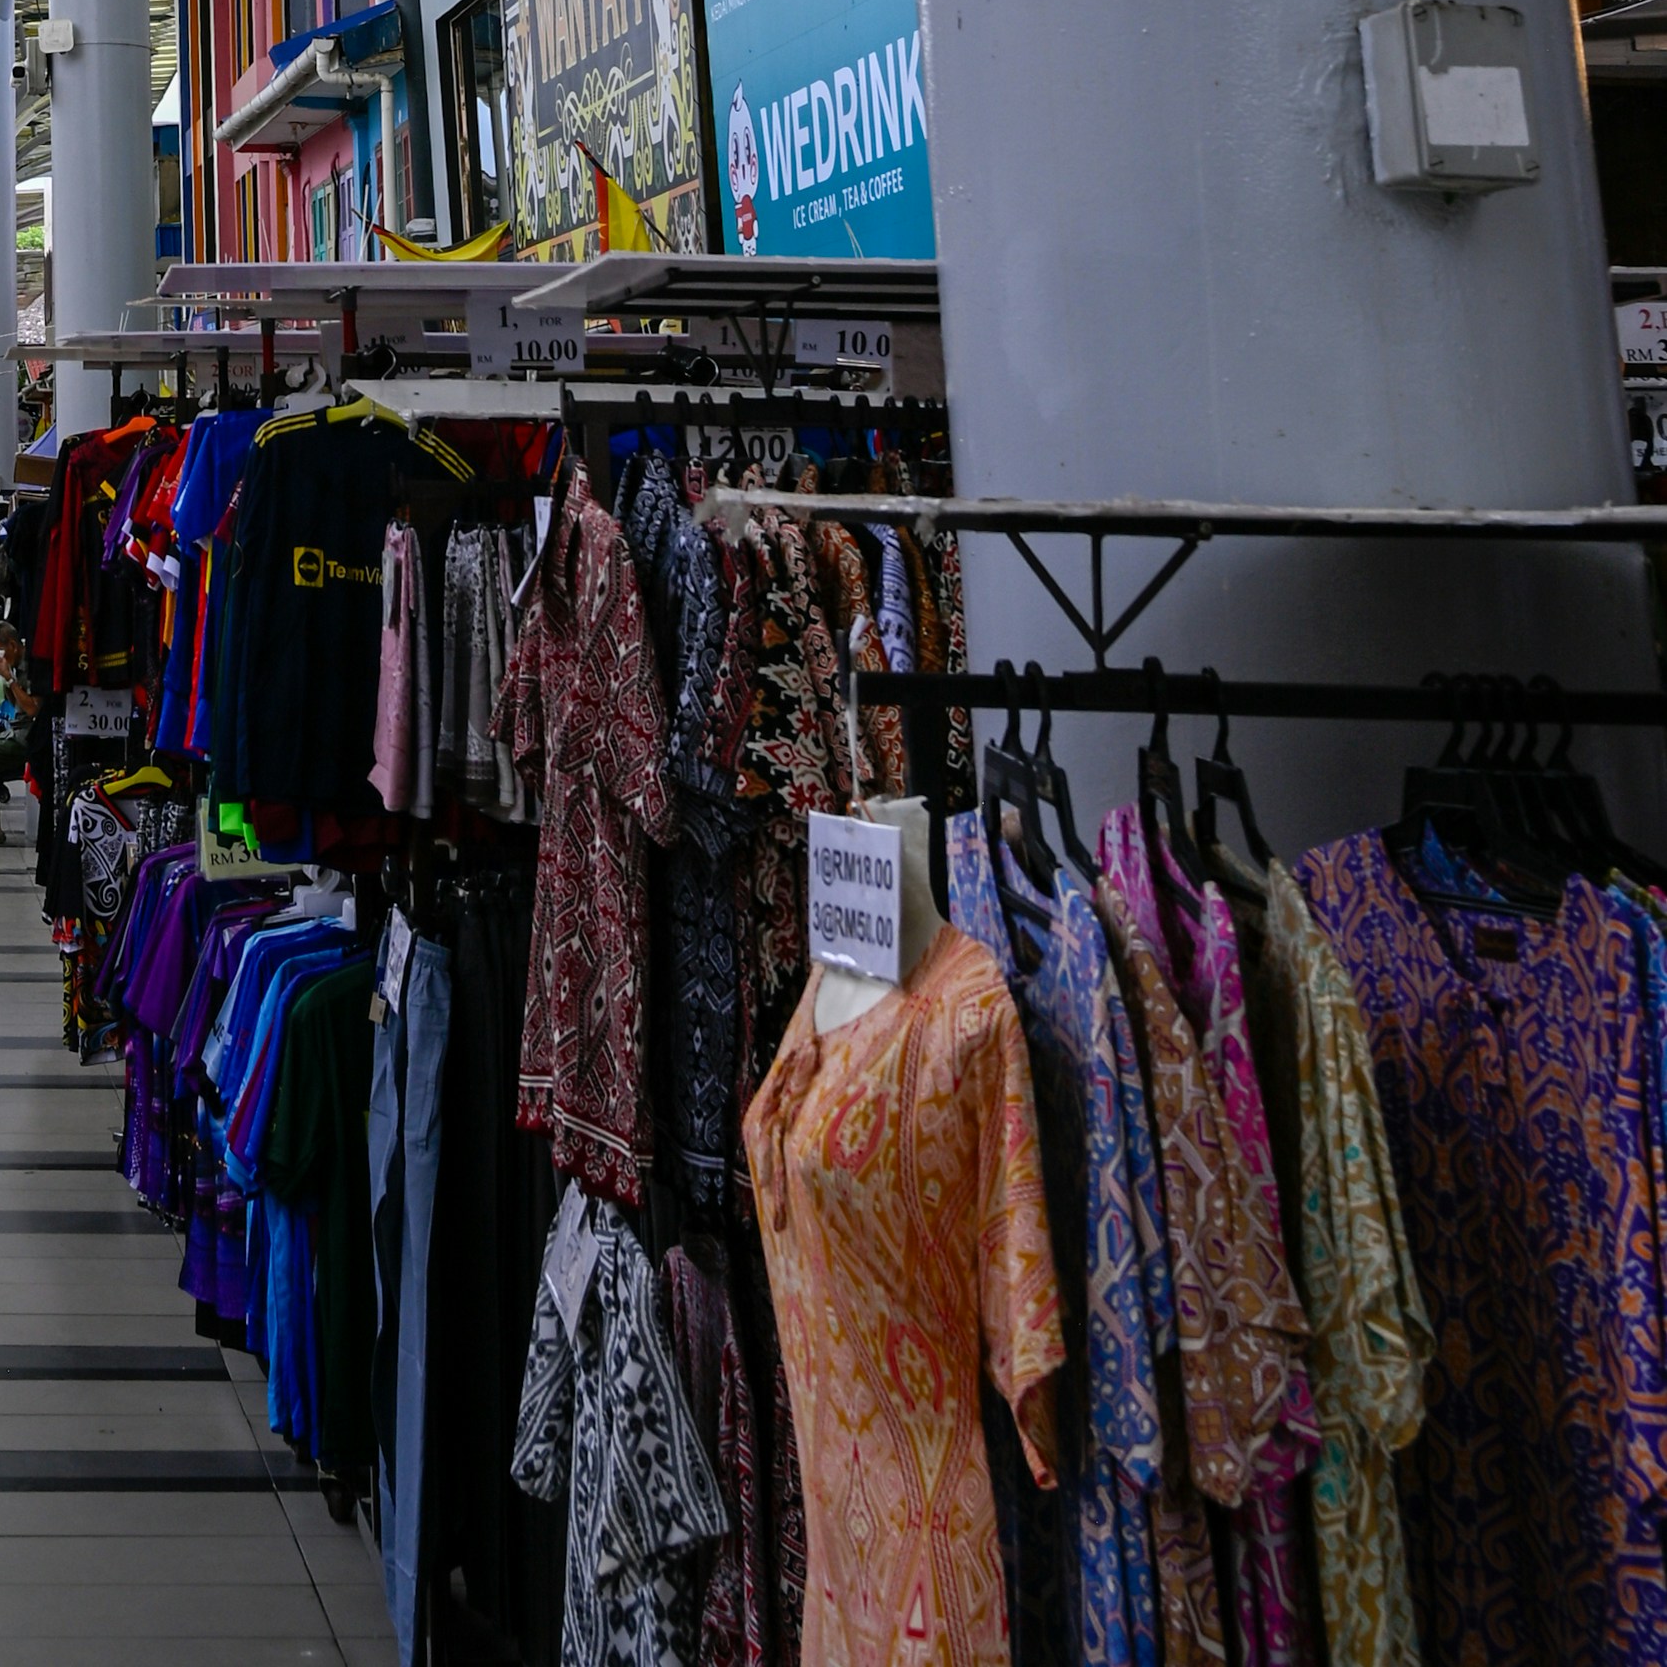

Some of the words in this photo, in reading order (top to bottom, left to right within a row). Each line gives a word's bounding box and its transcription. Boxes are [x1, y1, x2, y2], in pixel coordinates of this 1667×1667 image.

[710, 0, 728, 23] KEDAI
[760, 30, 928, 201] WEDRINK
[792, 205, 806, 230] ICE
[868, 167, 904, 202] COFFEE
[539, 316, 563, 327] FOR
[477, 354, 493, 364] RM
[515, 339, 578, 361] 10.00
[1626, 348, 1654, 361] RM
[211, 852, 234, 866] RM
[813, 847, 894, 891] 1@RM18.00
